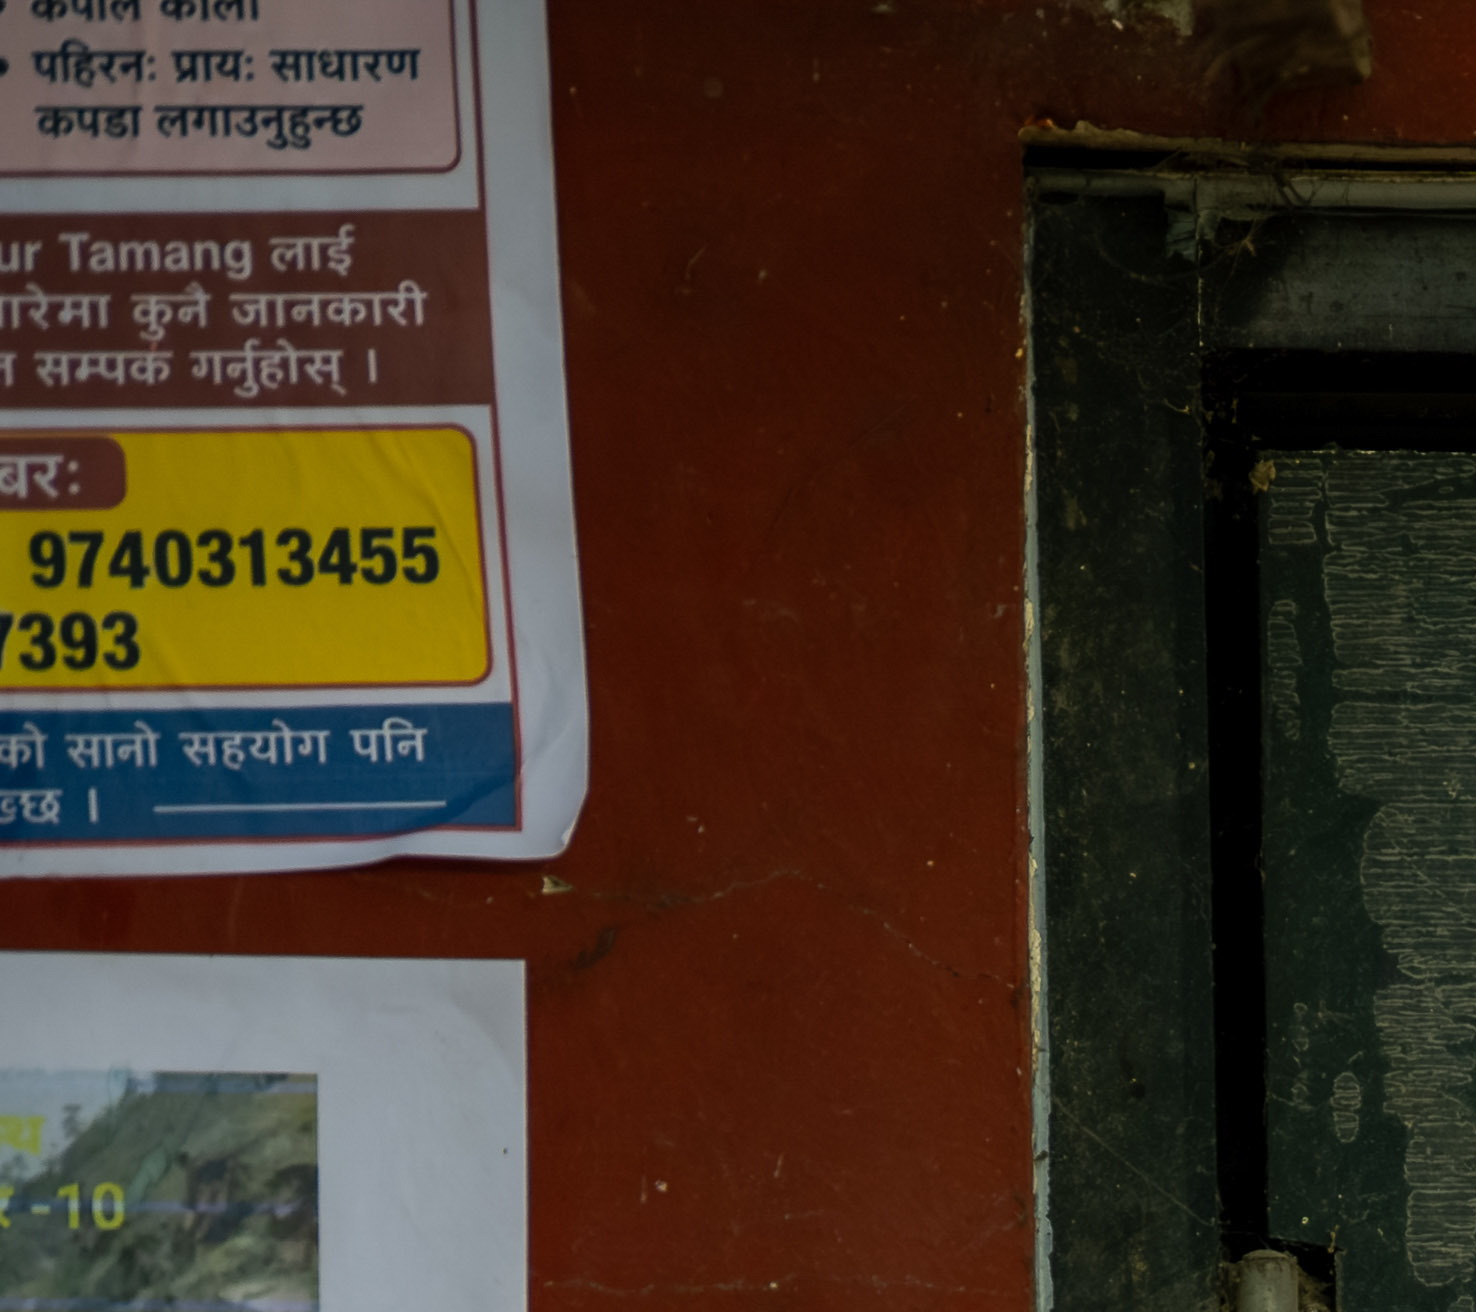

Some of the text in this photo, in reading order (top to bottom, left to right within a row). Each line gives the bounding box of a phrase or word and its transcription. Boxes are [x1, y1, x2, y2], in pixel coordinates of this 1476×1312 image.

[270, 49, 420, 83] साधारण
[34, 103, 364, 149] कपडा लगाउनुहुन्छ
[57, 223, 356, 280] Tamang लाई
[130, 278, 429, 342] कुनै जानकारी
[190, 337, 347, 398] गर्नुहोस्
[28, 526, 440, 589] 9740313455
[64, 718, 428, 770] सानो सहयोग पनि
